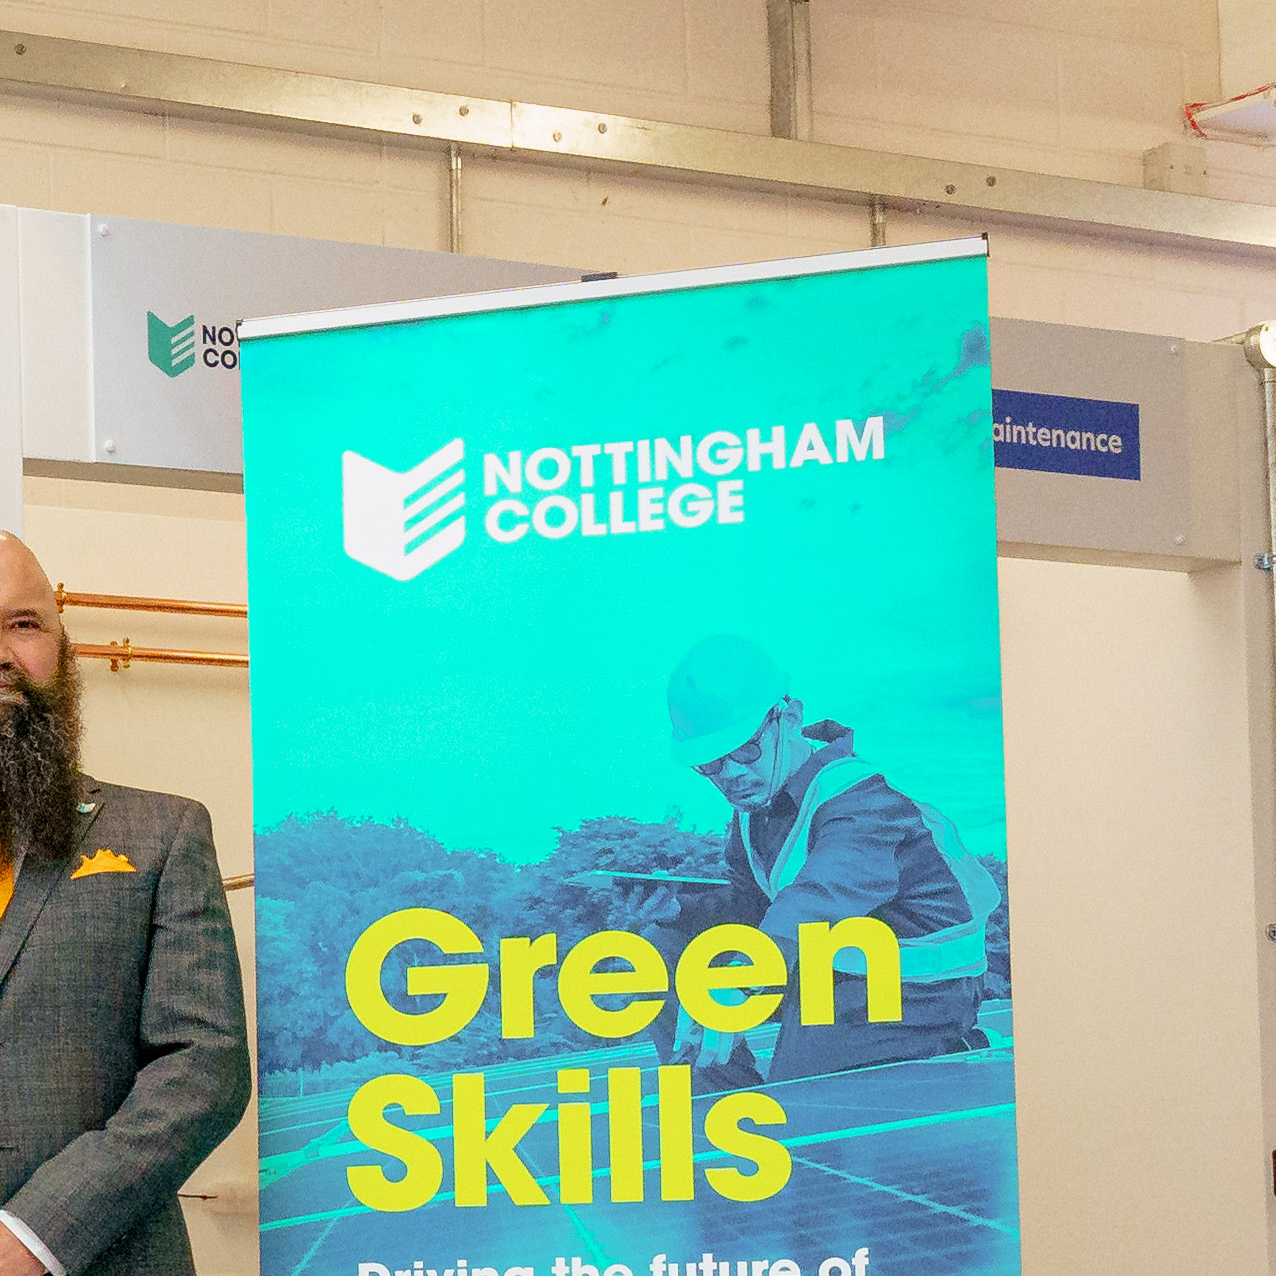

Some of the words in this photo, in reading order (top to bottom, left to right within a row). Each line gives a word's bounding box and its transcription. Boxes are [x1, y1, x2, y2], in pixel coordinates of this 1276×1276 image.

[483, 416, 886, 495] NOTTINGHAM
[993, 416, 1123, 454] aintenance
[484, 479, 745, 543] COLLEGE
[345, 907, 903, 1046] Green
[346, 1064, 793, 1212] Skills
